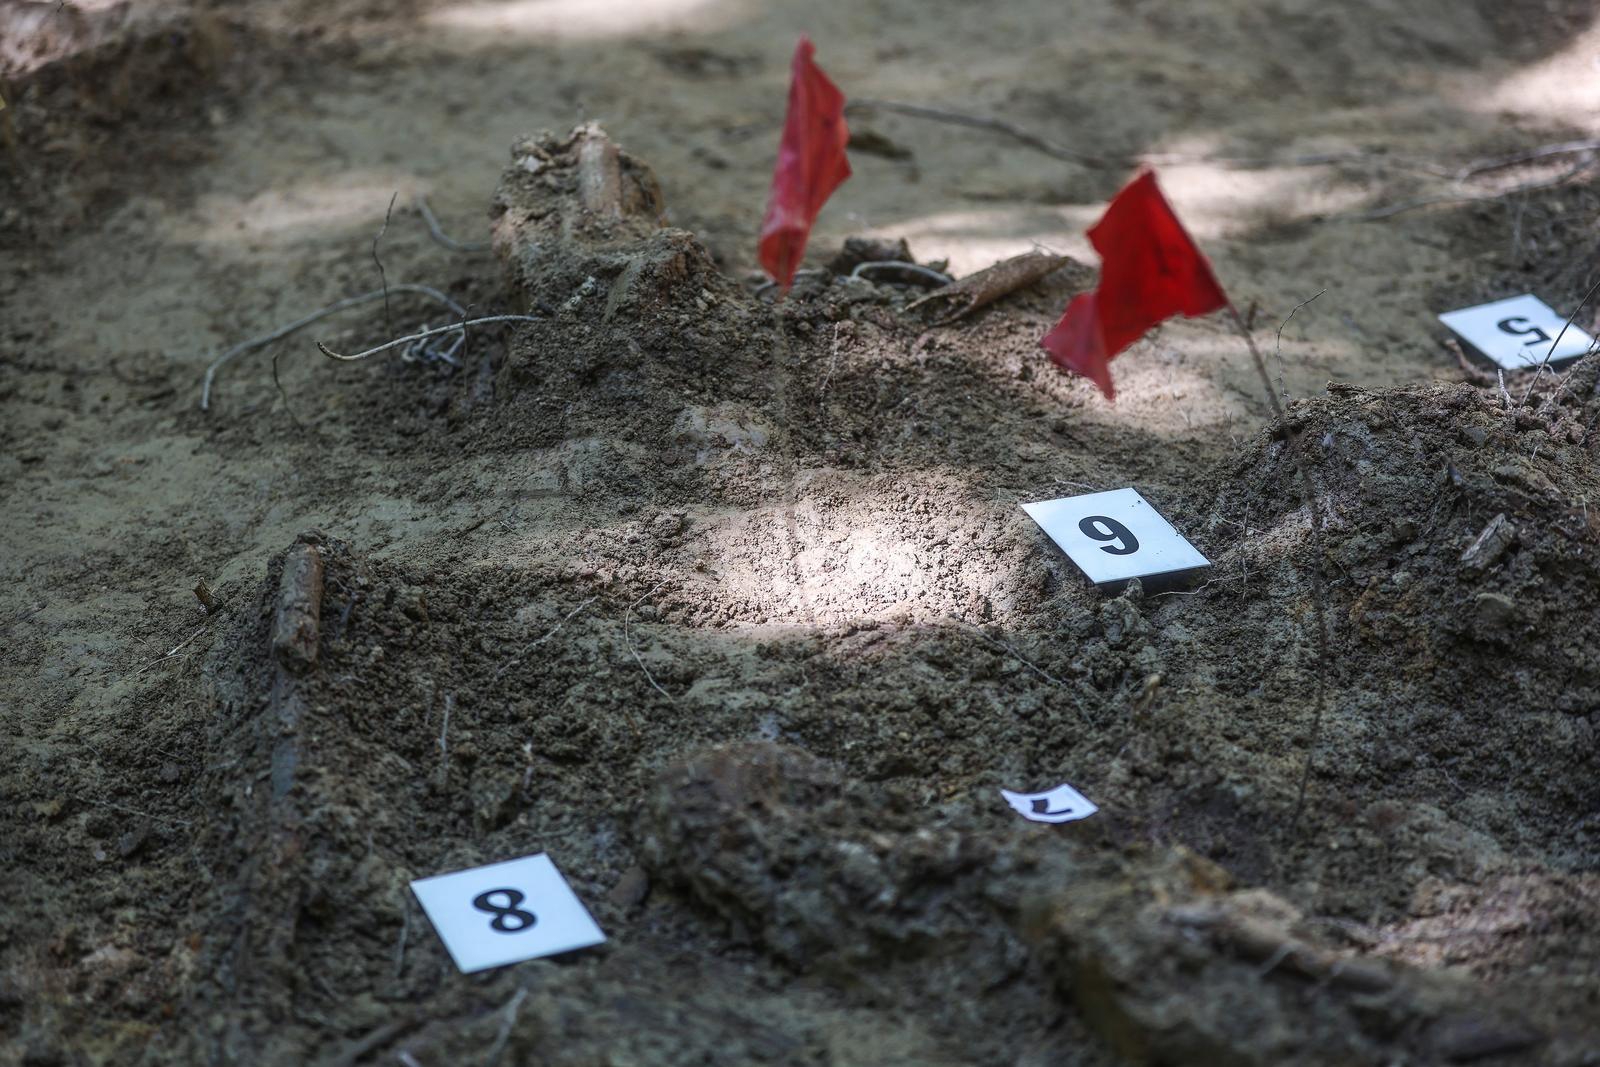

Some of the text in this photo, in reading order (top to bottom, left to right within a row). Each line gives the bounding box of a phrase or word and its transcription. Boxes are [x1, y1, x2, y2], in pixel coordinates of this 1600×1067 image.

[1497, 317, 1551, 346] 5
[1031, 798, 1073, 815] 7
[472, 888, 537, 933] 8
